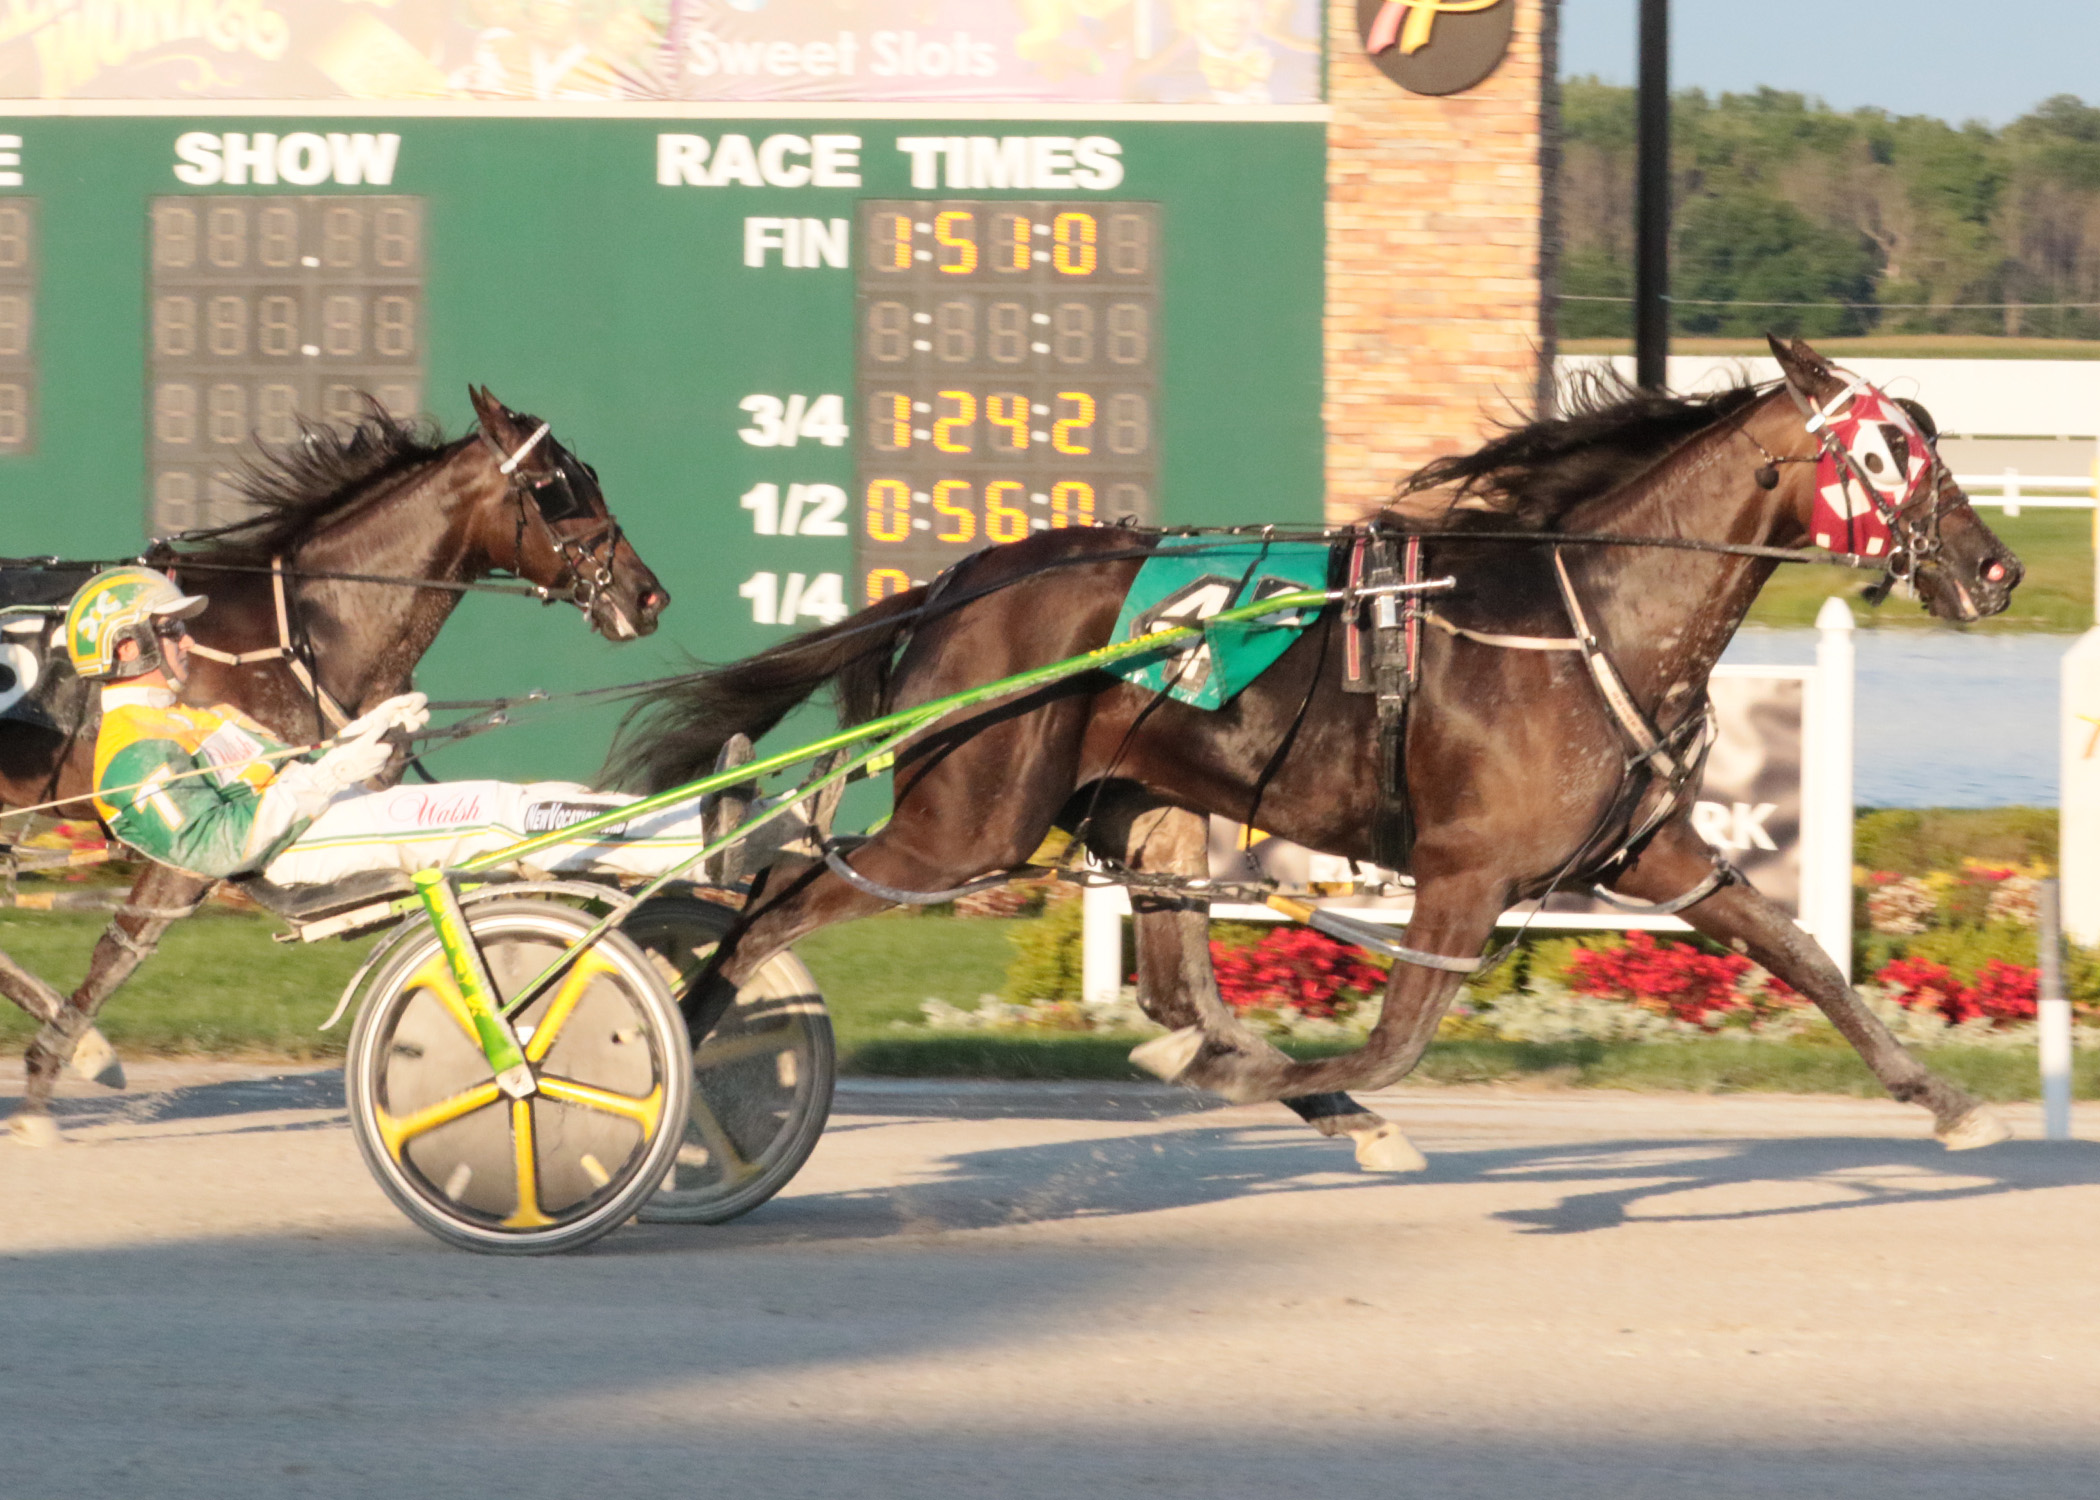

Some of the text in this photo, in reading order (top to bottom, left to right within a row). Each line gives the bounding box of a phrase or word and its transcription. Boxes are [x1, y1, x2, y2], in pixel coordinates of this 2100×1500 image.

[686, 29, 998, 77] Sweet Slots
[173, 131, 401, 185] SHOW
[657, 133, 1125, 190] RACE TIMES
[743, 217, 849, 268] FIN
[738, 393, 849, 447] 3/4
[740, 482, 848, 536] 1/2
[739, 571, 849, 625] 1/4
[132, 761, 186, 833] 1
[388, 791, 482, 826] Walsh
